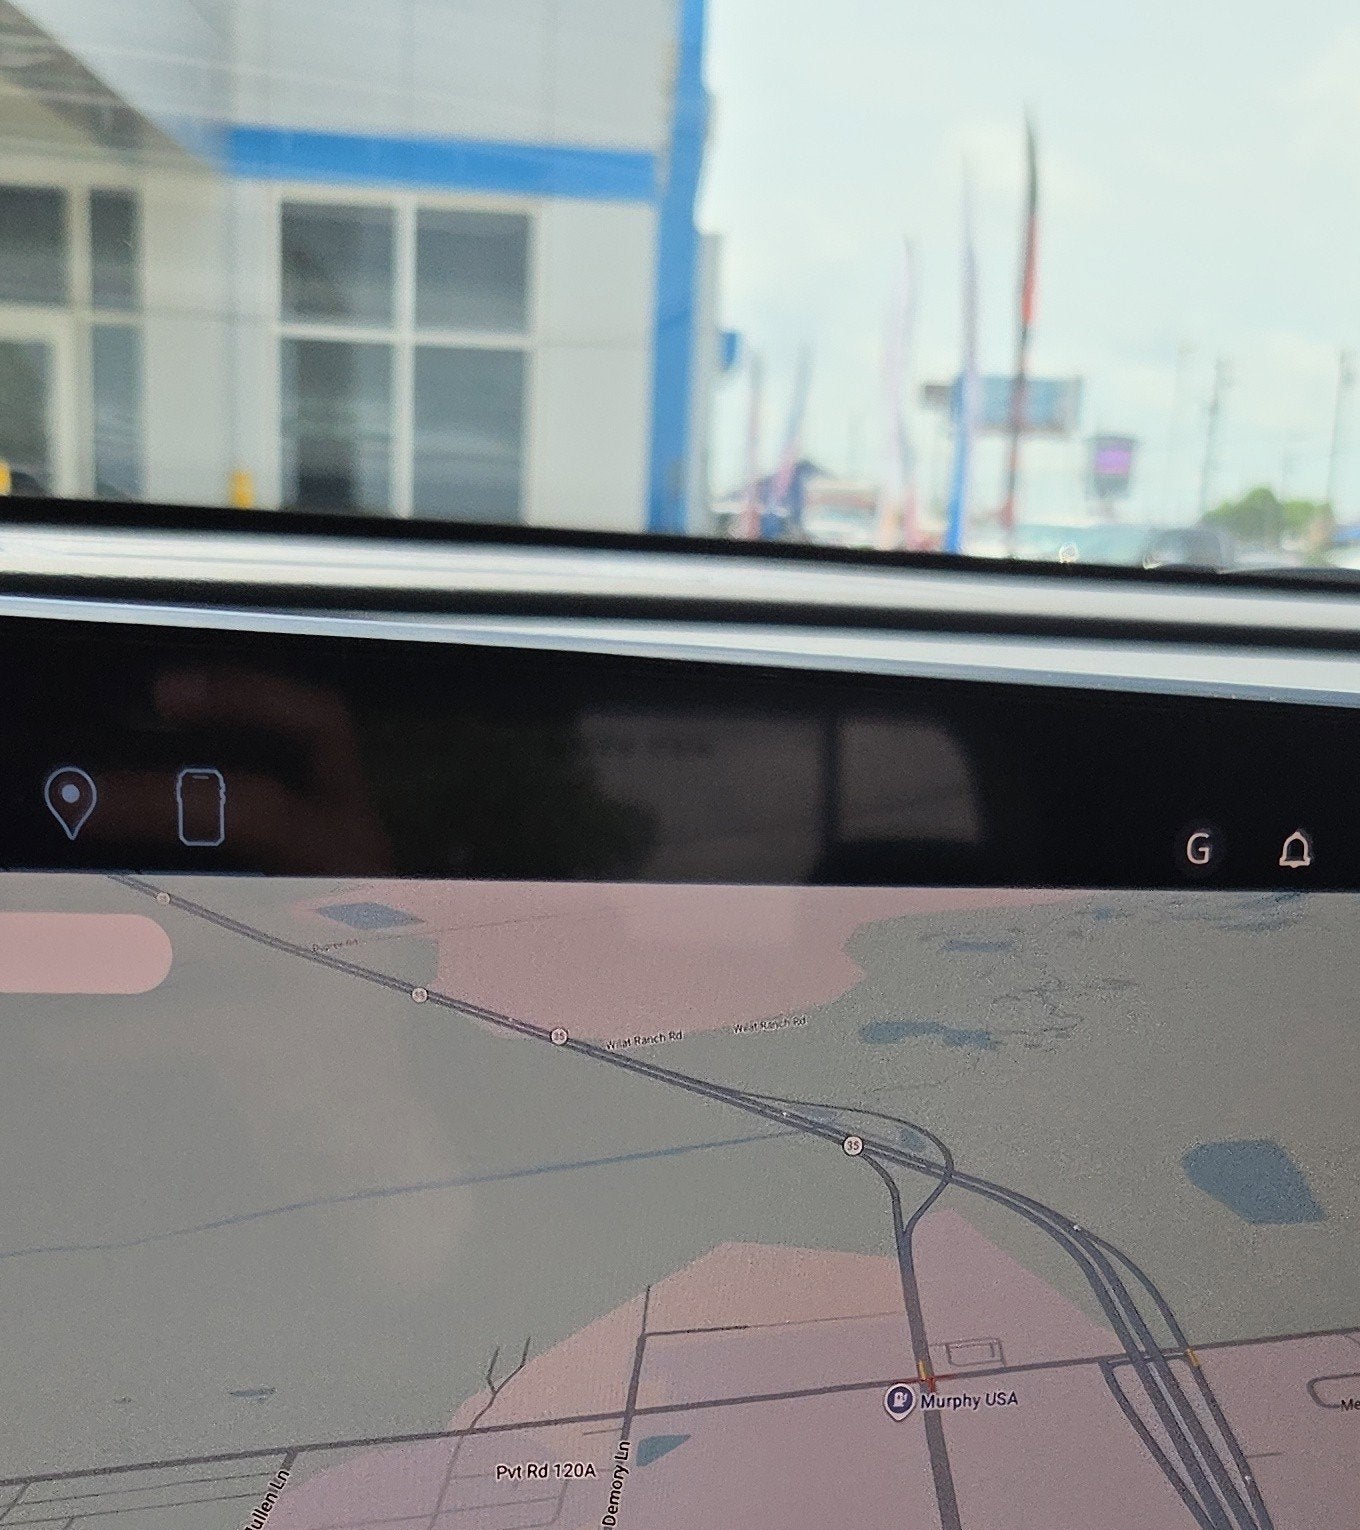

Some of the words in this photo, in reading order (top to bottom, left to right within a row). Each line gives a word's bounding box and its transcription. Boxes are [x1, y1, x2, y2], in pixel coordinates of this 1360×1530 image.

[1186, 832, 1210, 865] G
[634, 1034, 666, 1046] Ranch
[668, 1030, 683, 1042] Rd
[920, 1392, 982, 1411] Murphy
[985, 1390, 1019, 1406] USA
[613, 1440, 631, 1461] Ln
[269, 1469, 290, 1491] Ln
[496, 1464, 522, 1480] Pvt
[526, 1463, 549, 1479] Rd
[553, 1463, 597, 1479] 120A
[601, 1463, 631, 1527] Demory
